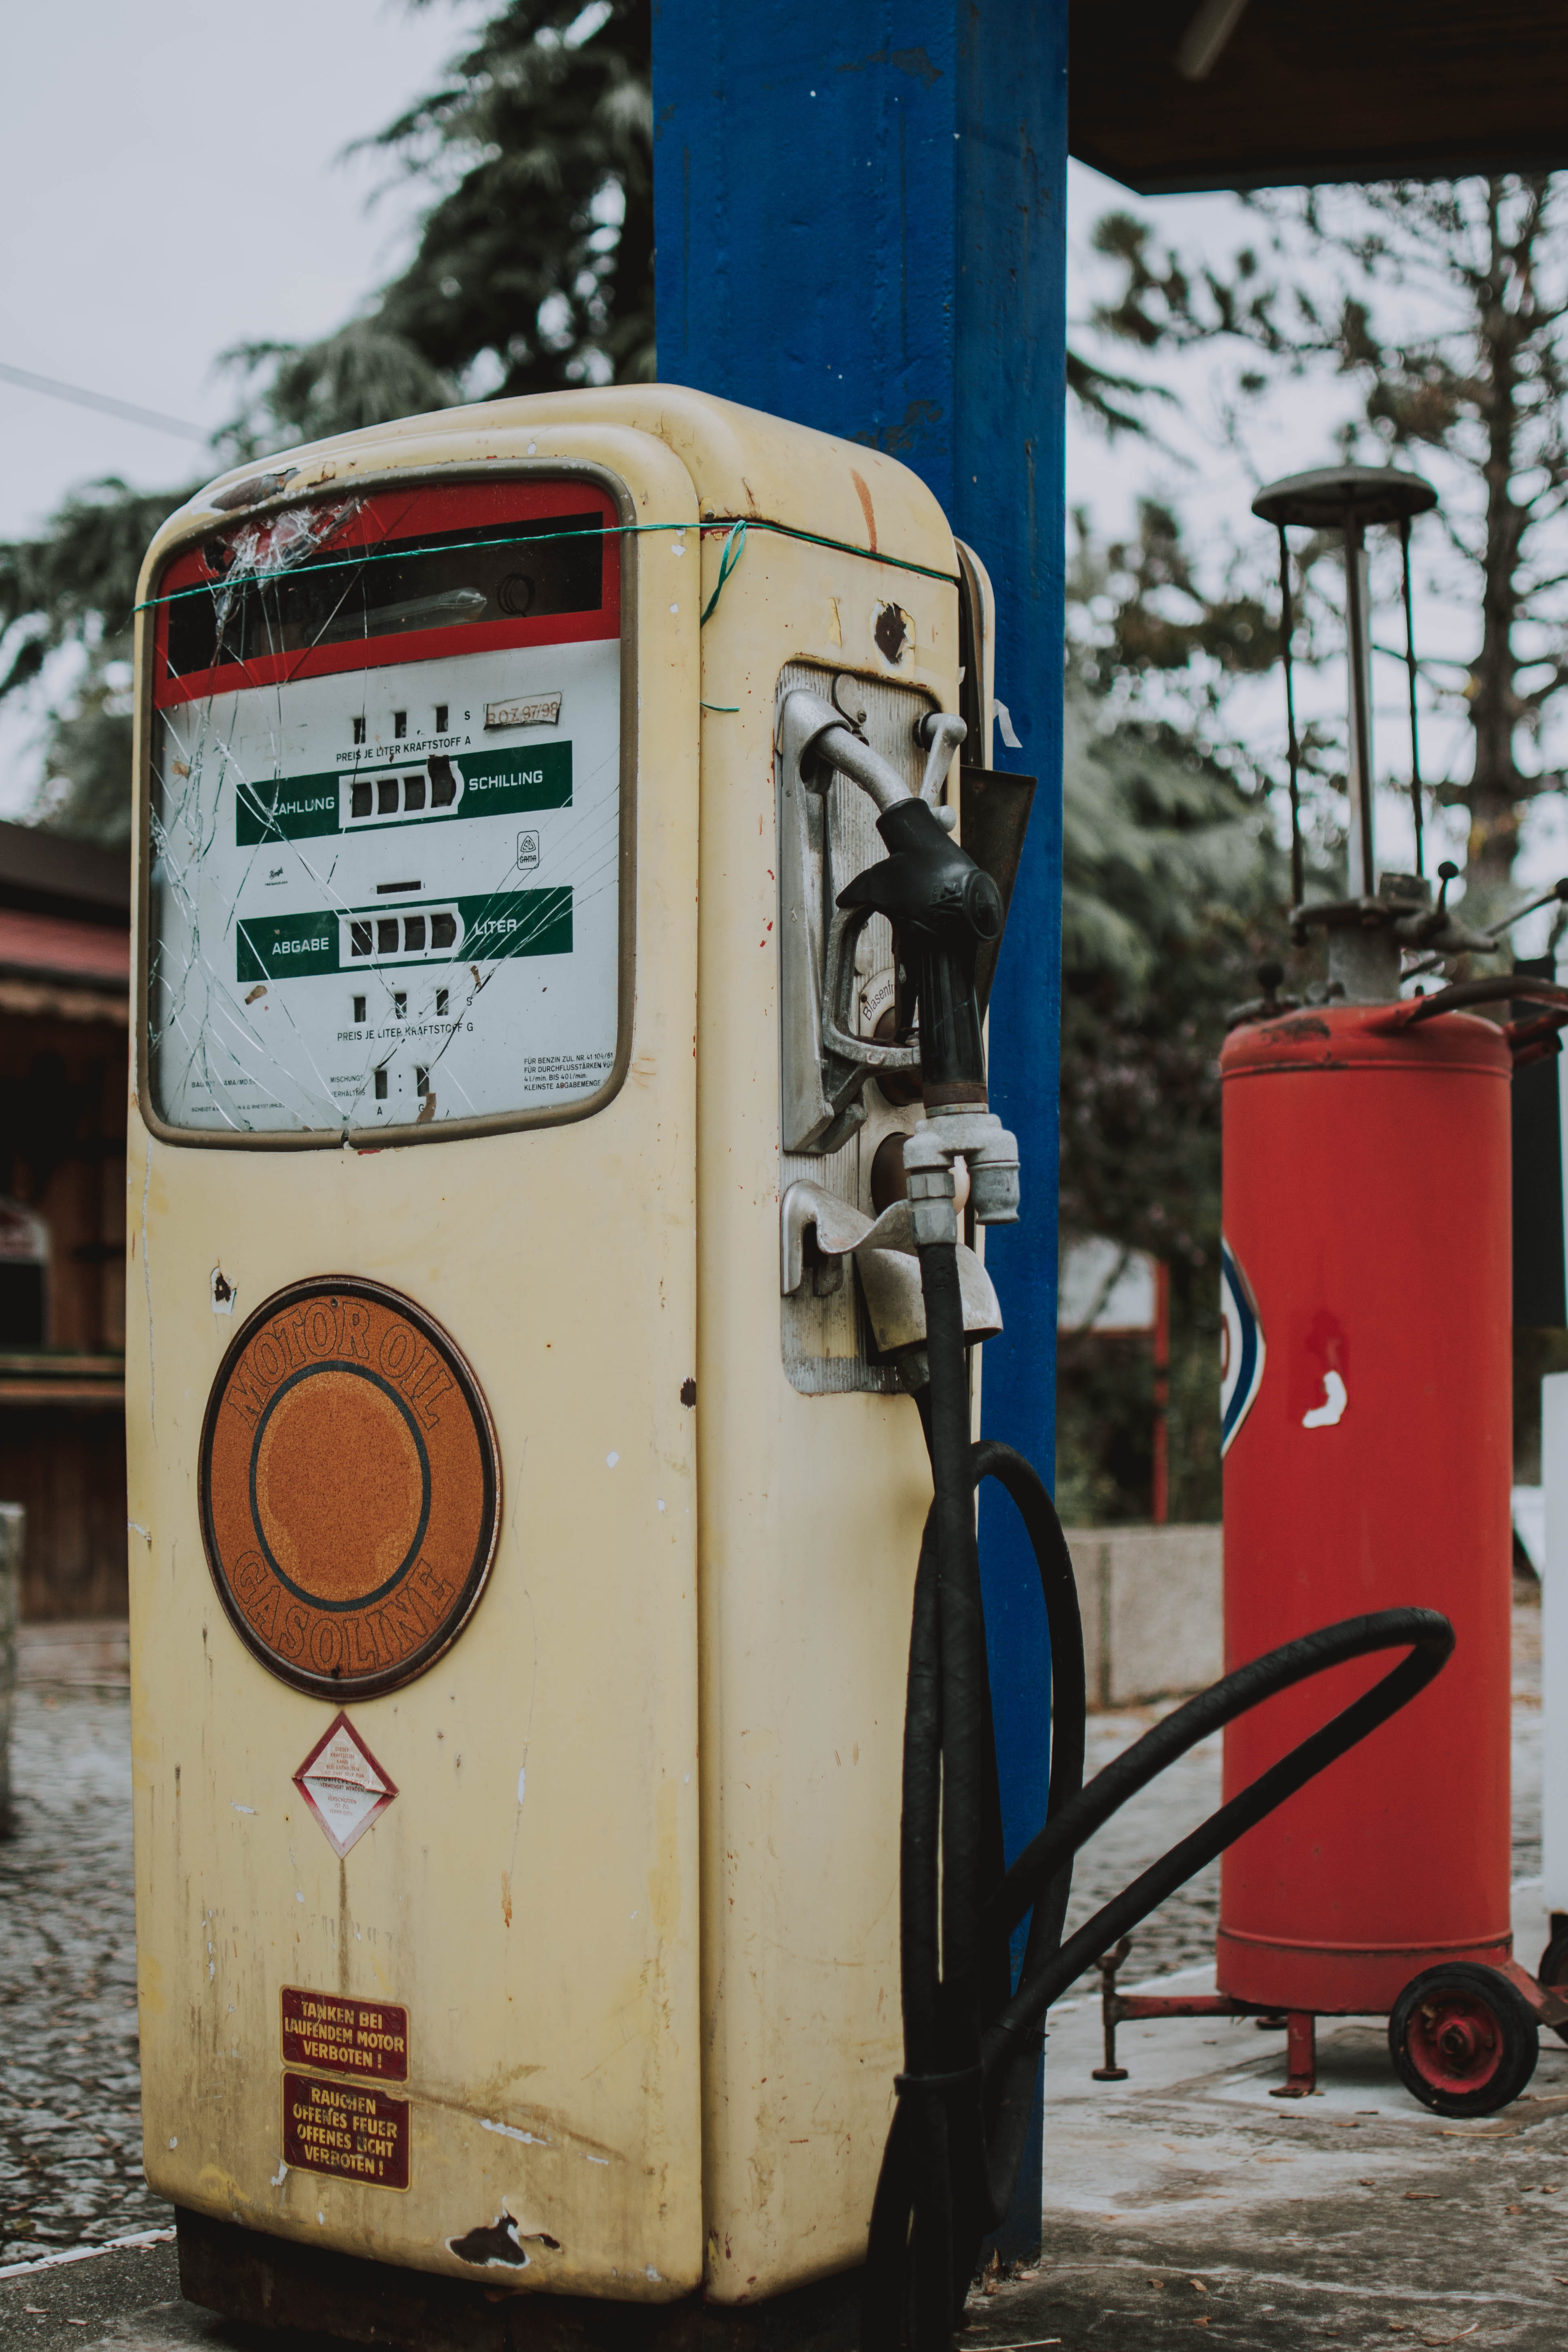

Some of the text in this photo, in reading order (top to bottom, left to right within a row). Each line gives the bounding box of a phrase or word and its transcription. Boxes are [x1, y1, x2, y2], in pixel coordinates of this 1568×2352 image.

[336, 736, 471, 762] PREIS JE LITER KRAFTSTOFF A
[272, 770, 543, 816] ZAHLUNG SCHILLING
[272, 919, 517, 955] ABGABE LITER
[337, 1023, 474, 1042] PREIS JE LITER KRAFTSTOFF G
[524, 1056, 536, 1065] FÜR
[538, 1056, 561, 1064] BENZIN
[524, 1065, 536, 1073] FÜR
[538, 1061, 602, 1073] DURCHFLUSSTÄRKEN
[524, 1083, 554, 1091] KLEINSTE
[556, 1080, 601, 1089] ABGABEMENGE
[377, 1107, 383, 1115] A
[226, 1302, 456, 1431] MOTOR OIL
[233, 1551, 455, 1672] GASOLINE
[301, 2001, 383, 2030] TANKEN BEI
[285, 2017, 404, 2053] LAUFENDEM MOTOR
[303, 2040, 373, 2068] VERBOTEN
[311, 2086, 376, 2115] RAUCHEN
[293, 2103, 398, 2139] OFFENES FEUER
[297, 2123, 394, 2158] OFFENES LICHT
[304, 2145, 375, 2174] VERBOTEN
